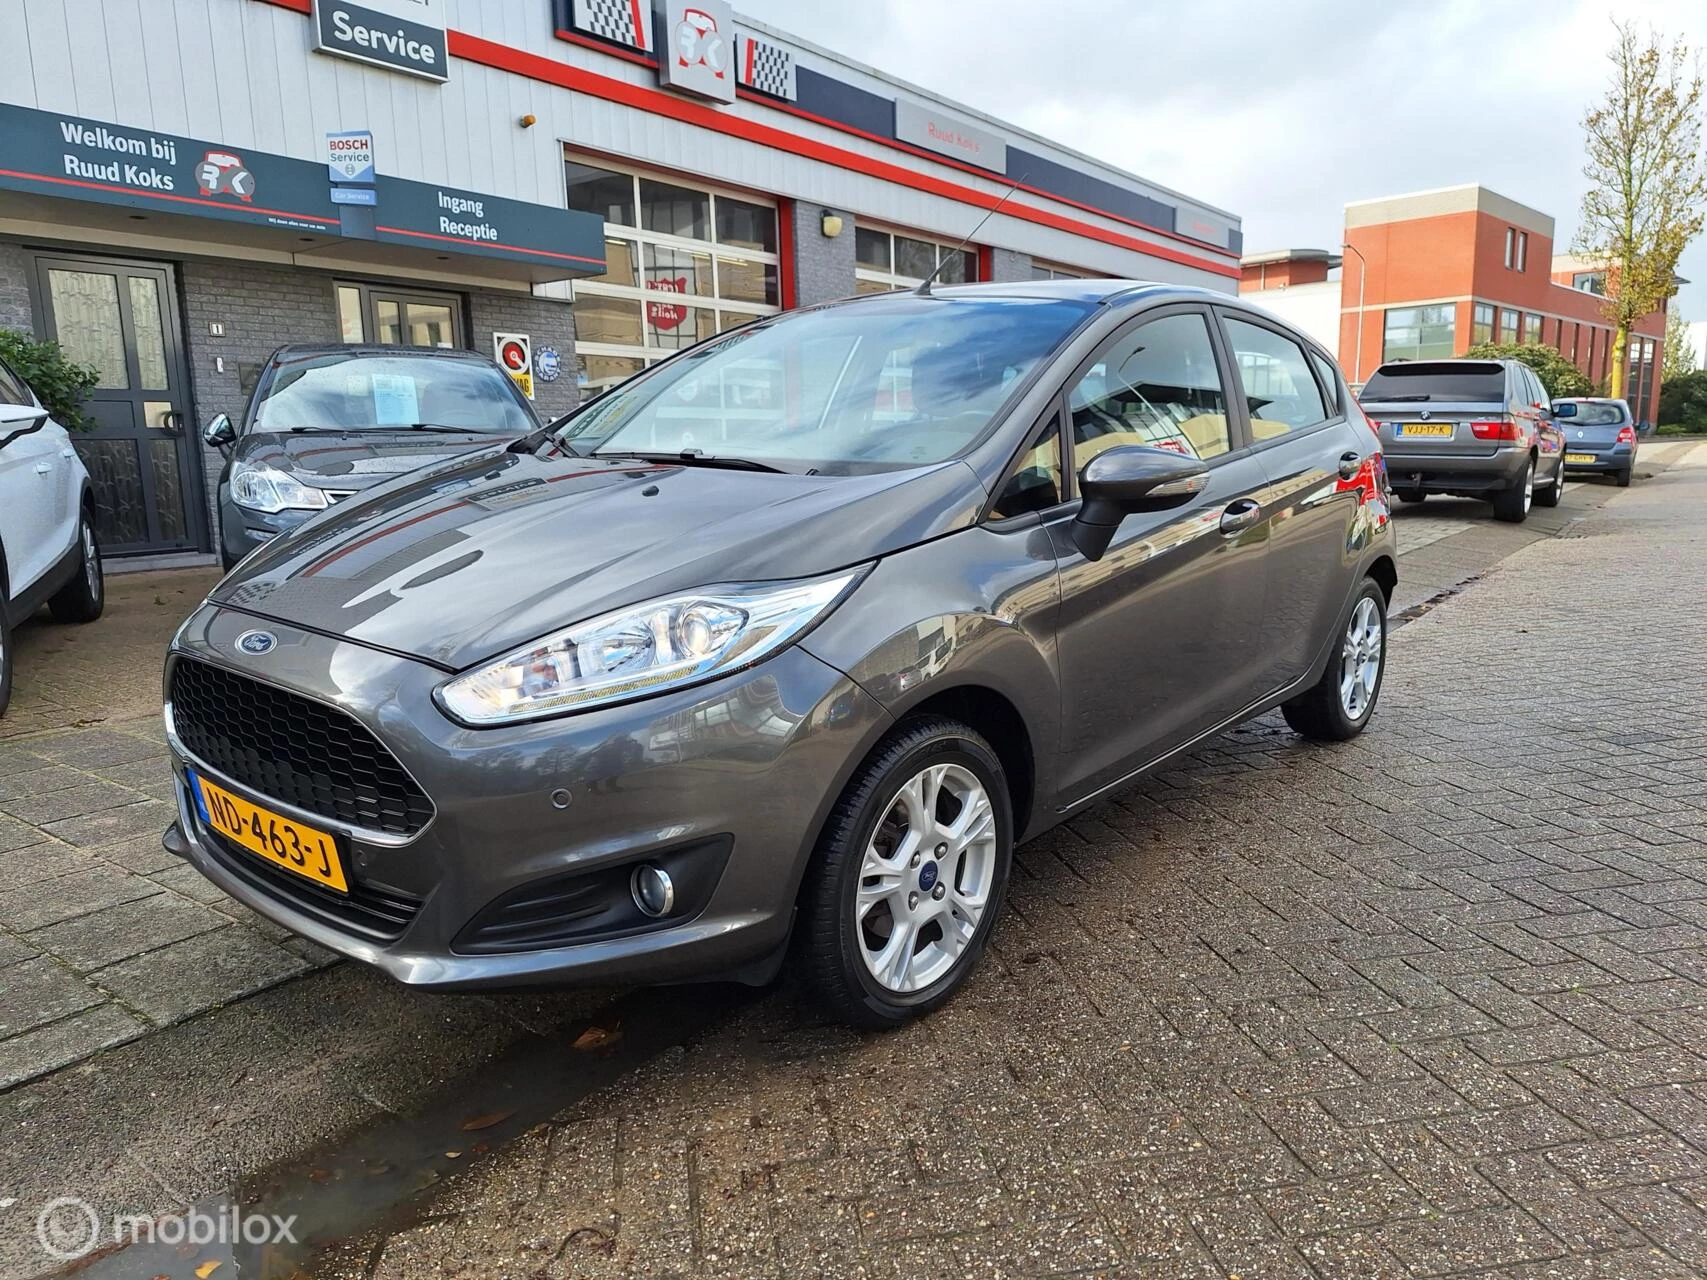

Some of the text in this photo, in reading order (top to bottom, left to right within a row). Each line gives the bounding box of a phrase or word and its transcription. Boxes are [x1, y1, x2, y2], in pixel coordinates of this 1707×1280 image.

[332, 10, 435, 64] Service
[60, 122, 177, 166] Welkom bij
[329, 139, 369, 151] BOSCH
[330, 151, 370, 162] Service
[63, 154, 174, 191] Ruud Koks
[438, 191, 484, 217] Ingang
[439, 216, 498, 240] Receptie
[206, 787, 331, 877] ND-463-J
